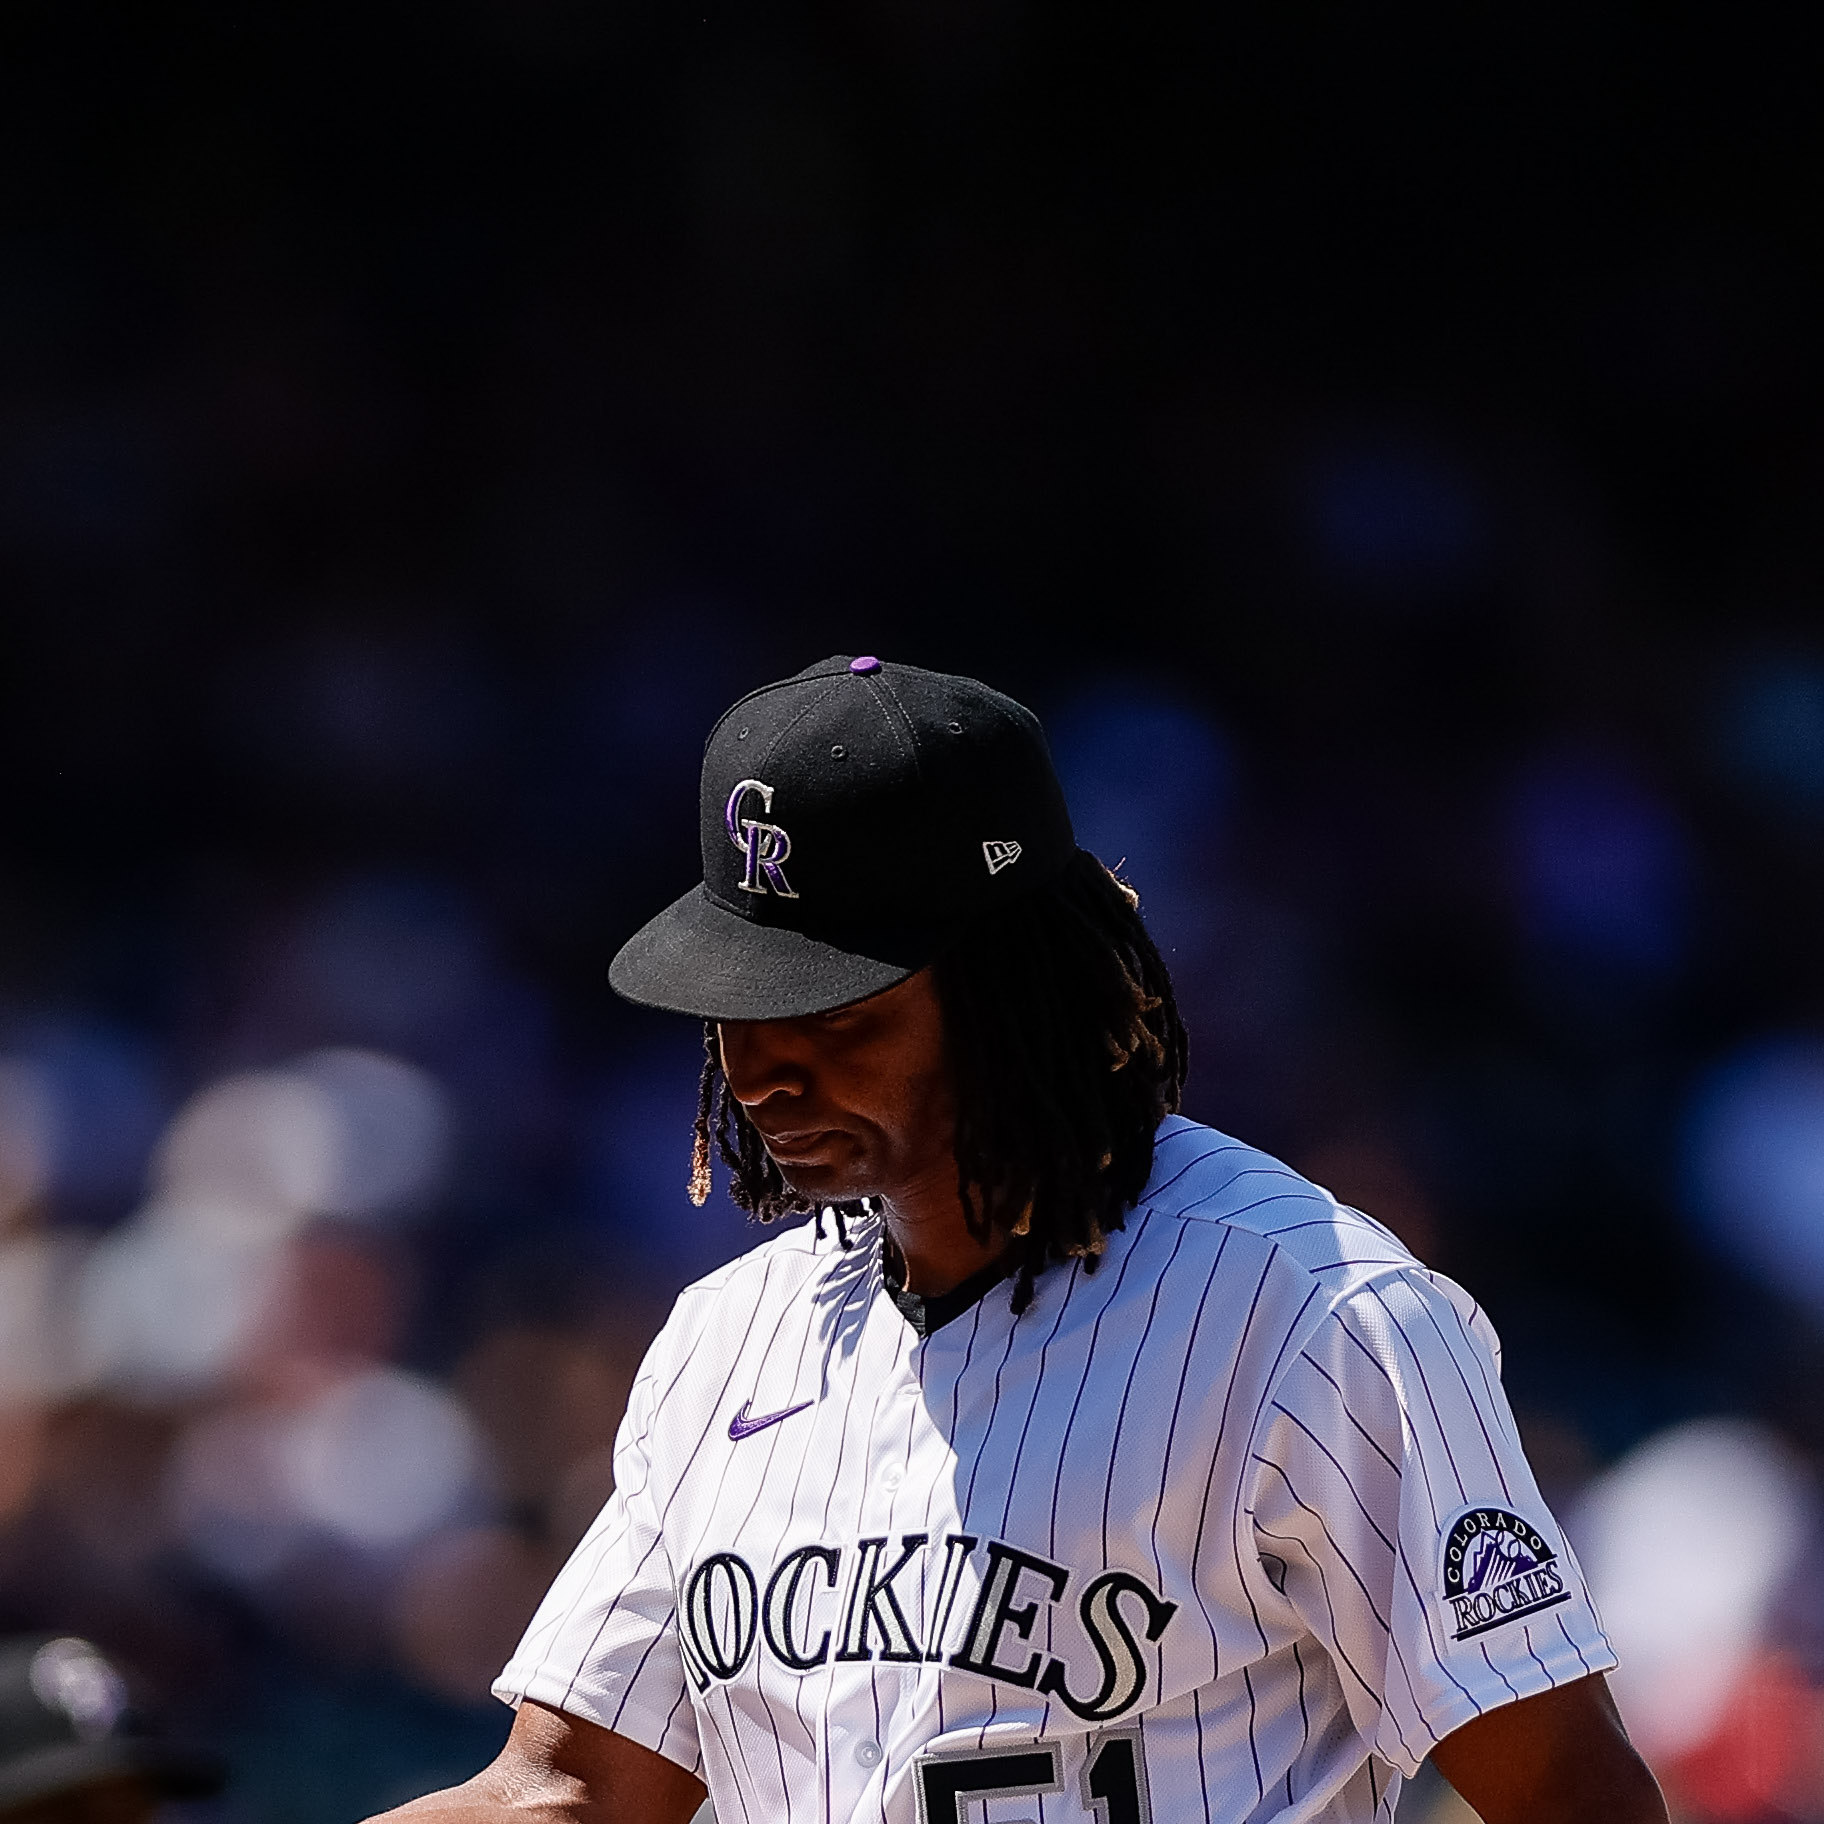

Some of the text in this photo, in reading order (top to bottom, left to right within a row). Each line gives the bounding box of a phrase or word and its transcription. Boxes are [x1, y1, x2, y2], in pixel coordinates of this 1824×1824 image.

[1447, 1512, 1543, 1583] COLORADO
[678, 1533, 1177, 1721] OCKIES
[1449, 1560, 1564, 1633] ROCKIES
